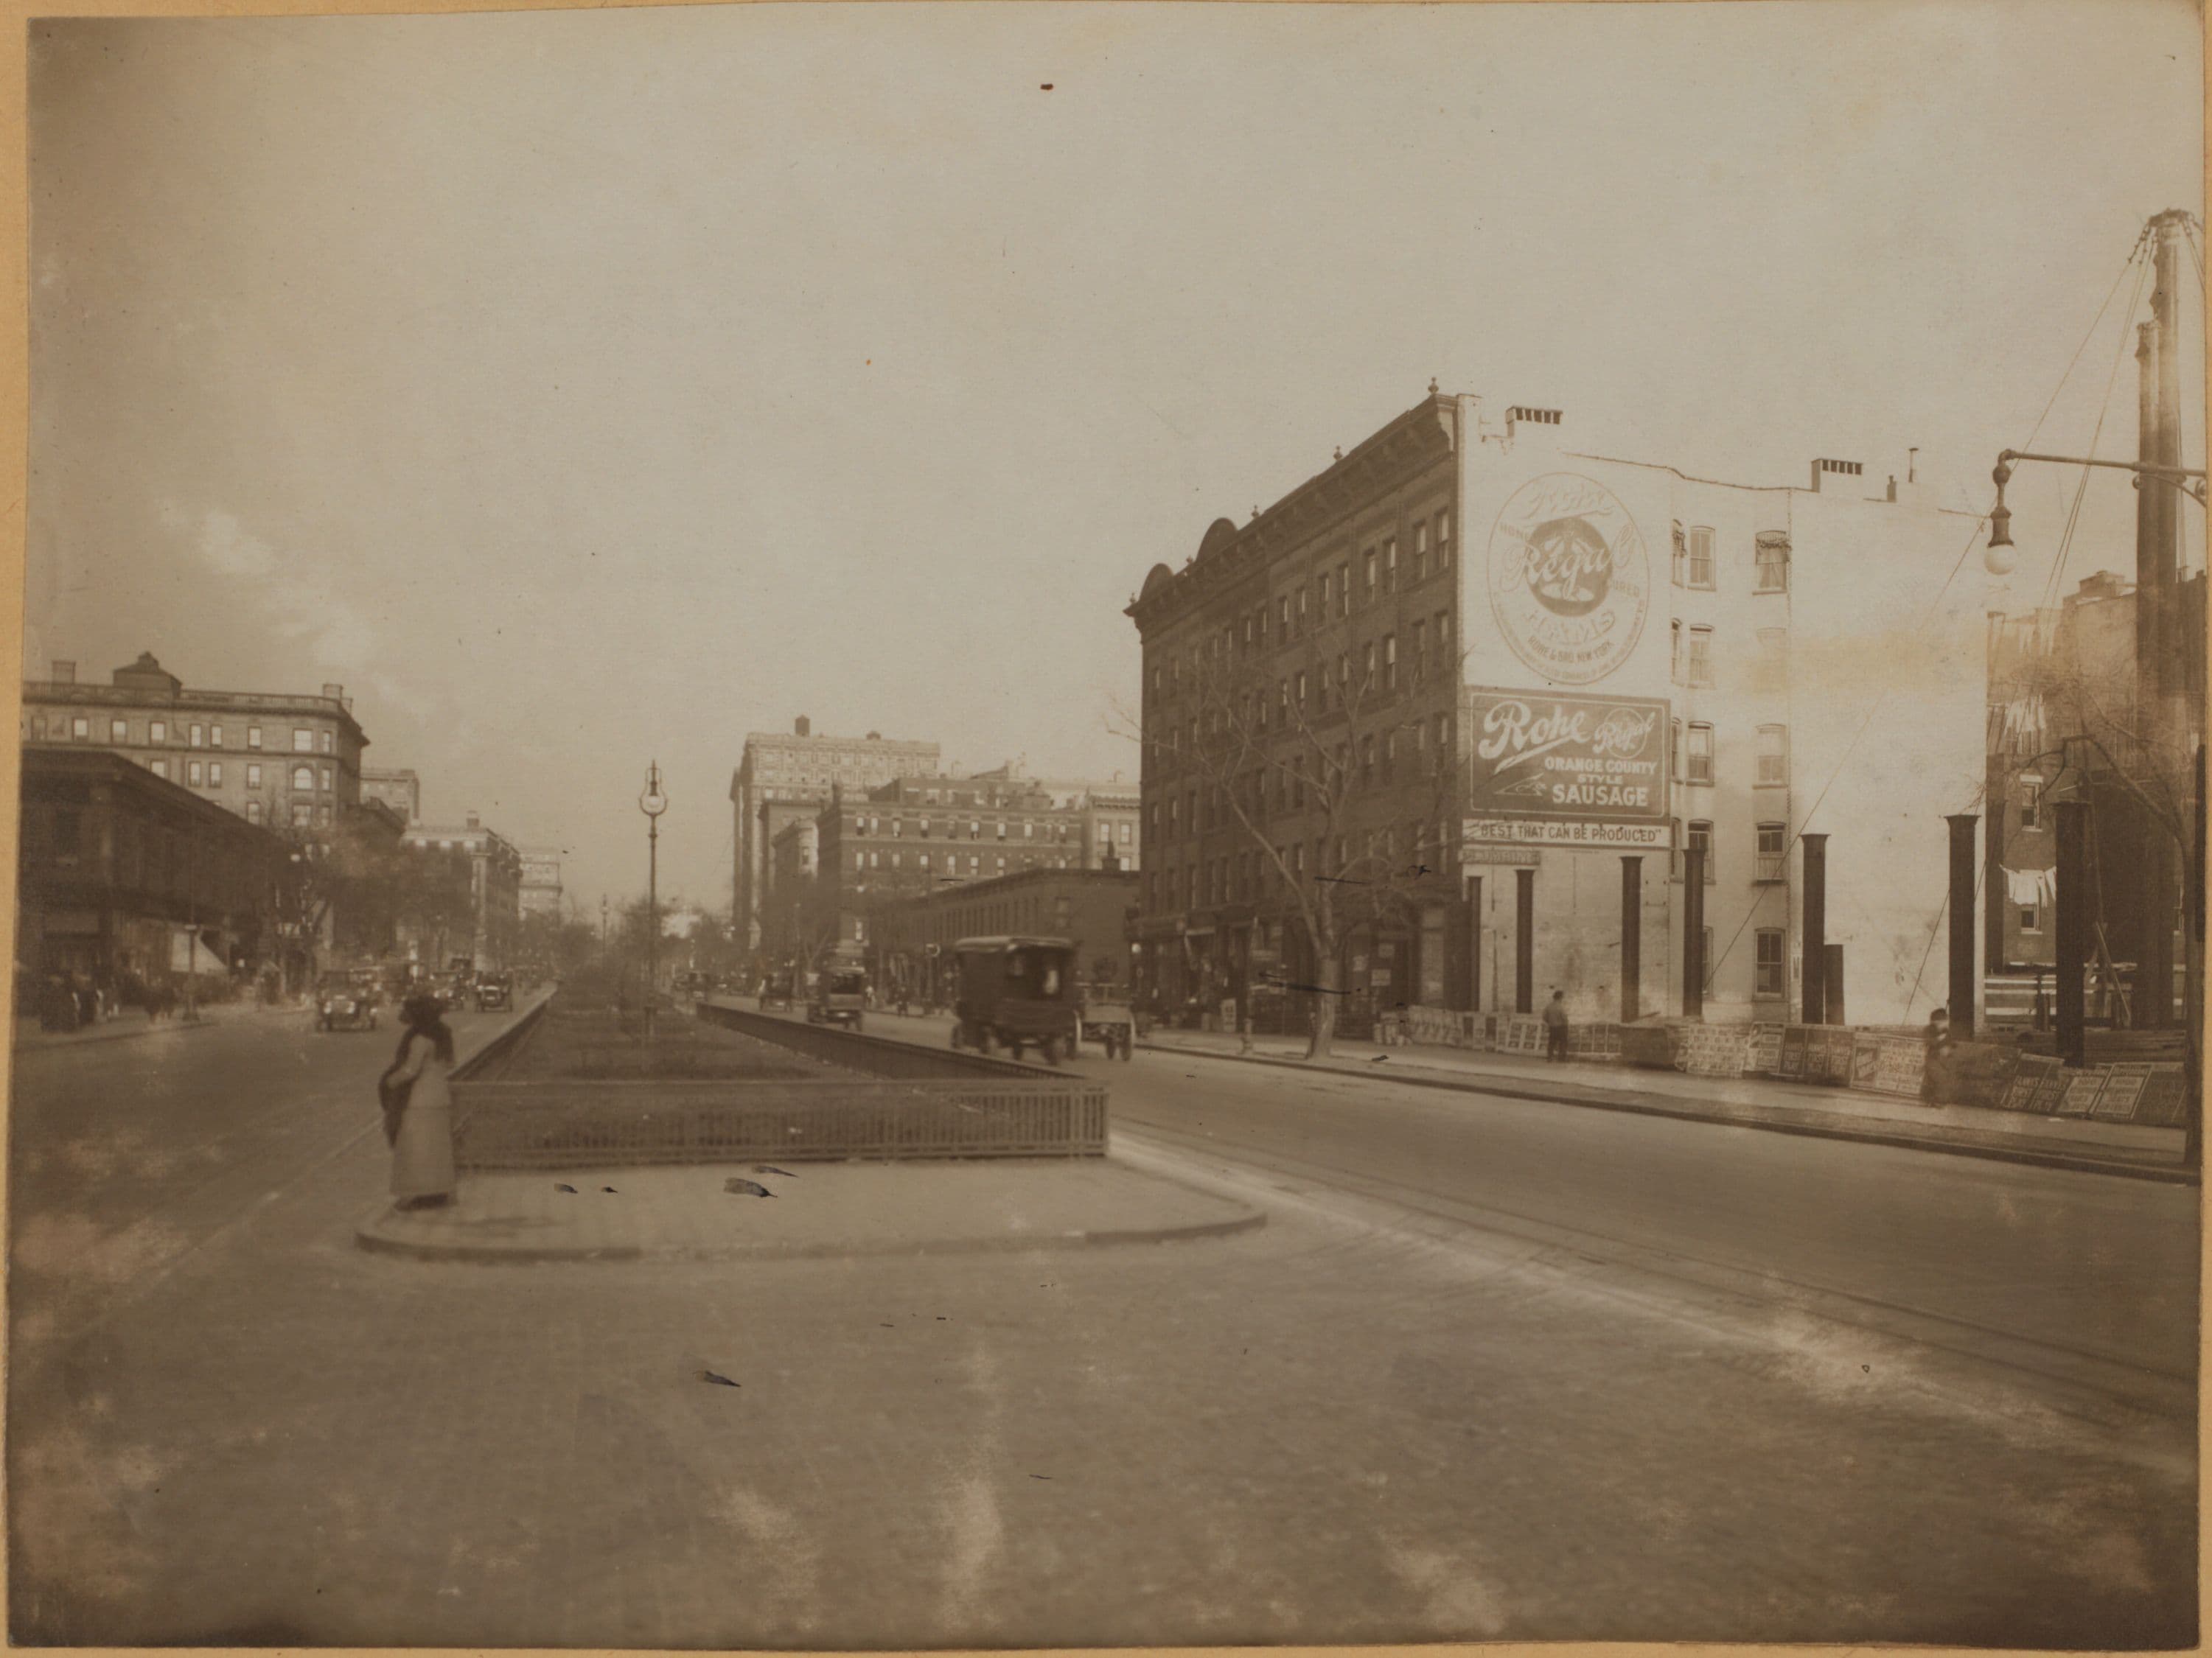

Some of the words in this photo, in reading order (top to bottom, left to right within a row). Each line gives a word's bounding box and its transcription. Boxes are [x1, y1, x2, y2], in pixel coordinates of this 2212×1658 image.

[1499, 523, 1637, 600] Regal
[1478, 700, 1591, 760] Rohe
[1544, 756, 1604, 773] ORANGE
[1605, 759, 1658, 774] COUNTY
[1577, 773, 1624, 785] STYLE
[1552, 783, 1650, 807] SAUSAGE
[1518, 825, 1546, 839] THAT
[1549, 826, 1570, 840] CAN
[1574, 828, 1588, 840] BE
